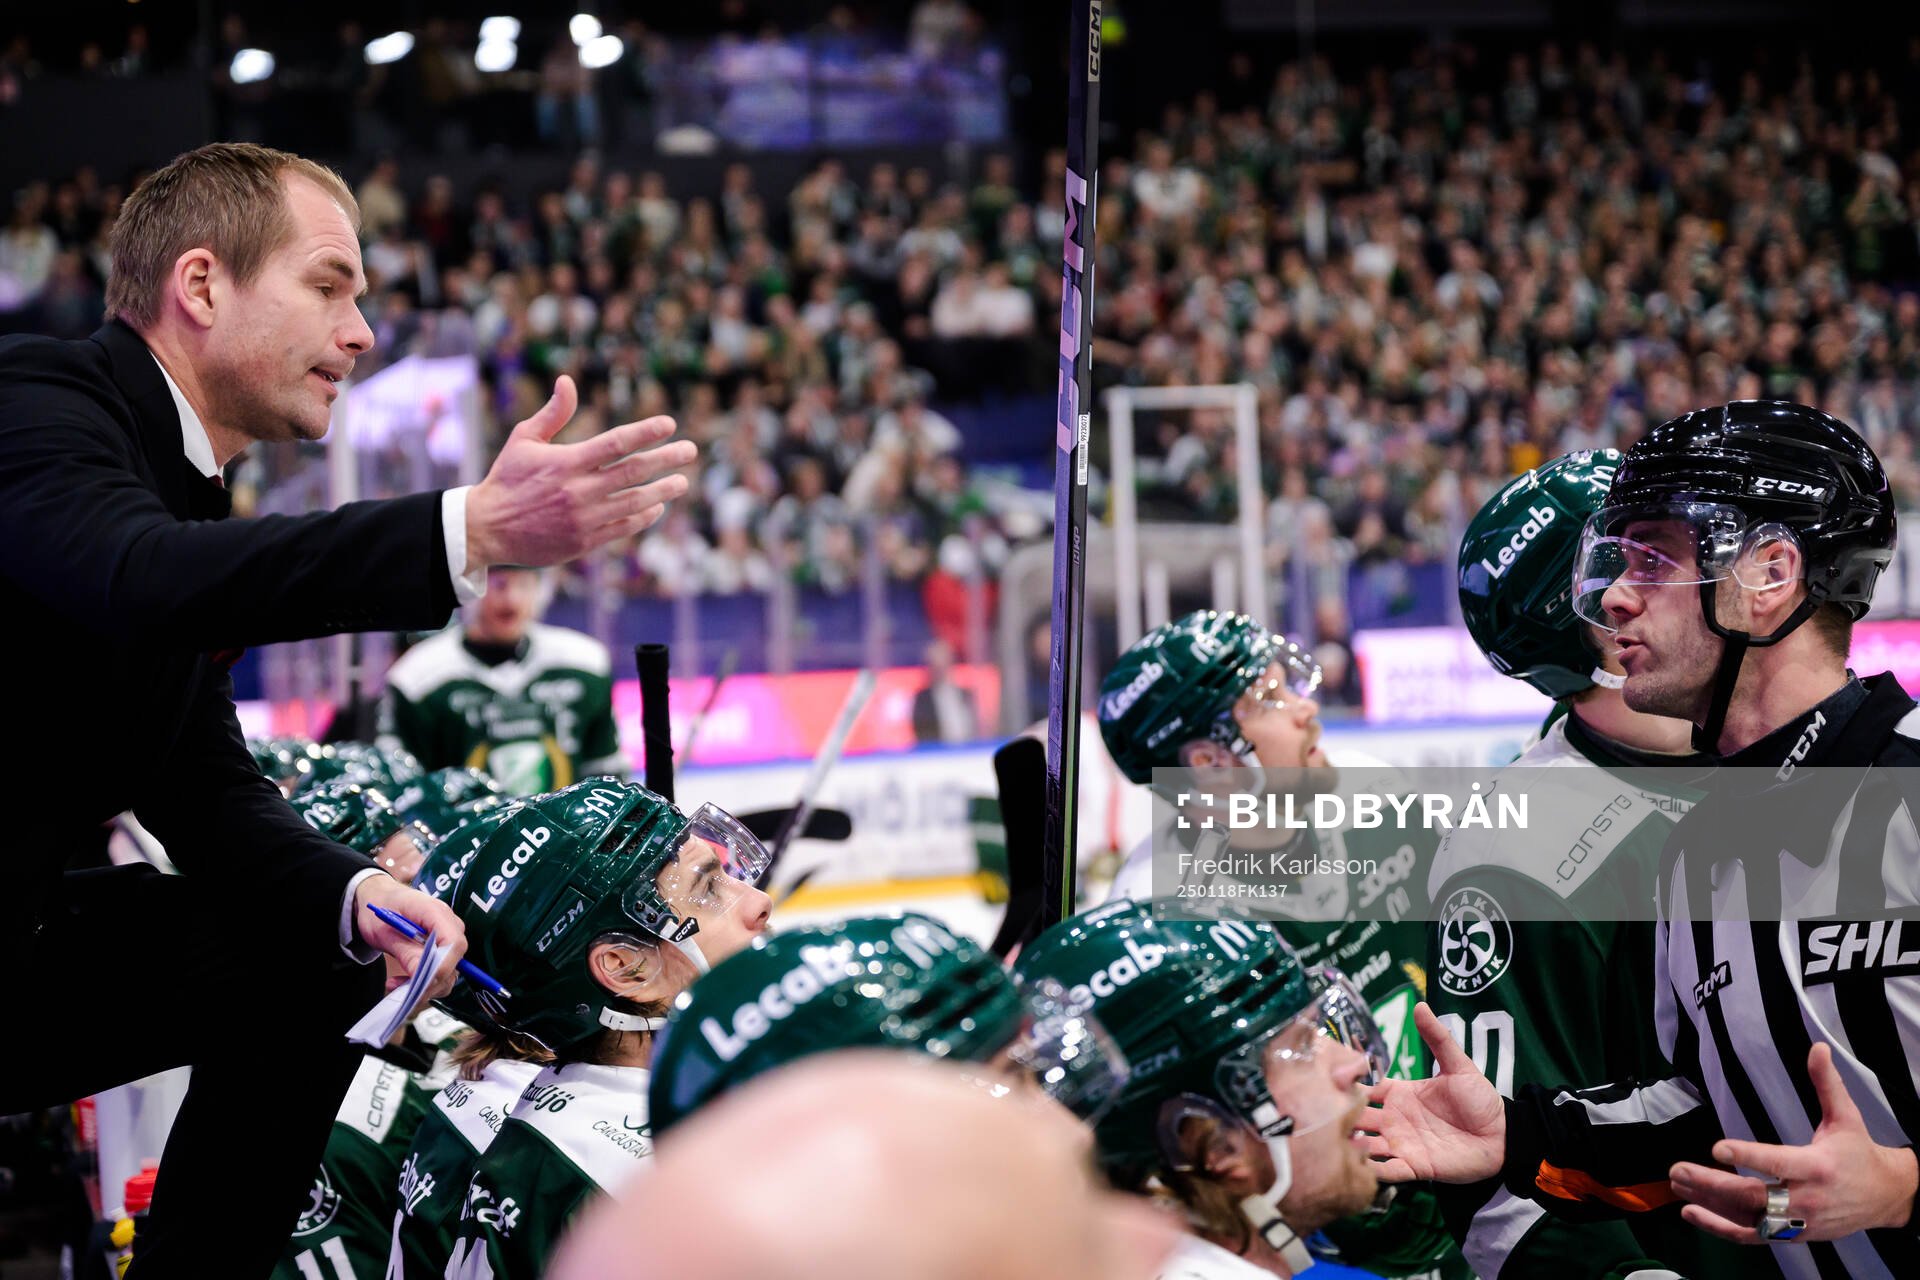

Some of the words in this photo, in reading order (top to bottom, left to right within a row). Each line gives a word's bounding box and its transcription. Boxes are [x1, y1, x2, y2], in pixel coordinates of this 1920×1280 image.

[1090, 6, 1100, 76] CCM
[1754, 476, 1825, 497] CCM
[1481, 506, 1556, 579] Lecab
[1105, 661, 1163, 720] Lecab
[1775, 710, 1827, 782] CCM
[419, 838, 482, 901] Lec
[470, 825, 551, 914] Lecab
[536, 899, 584, 952] CCM
[675, 918, 697, 943] CCM
[1804, 918, 1920, 976] SHL
[700, 945, 854, 1063] Lecab
[1694, 964, 1728, 1006] CCM
